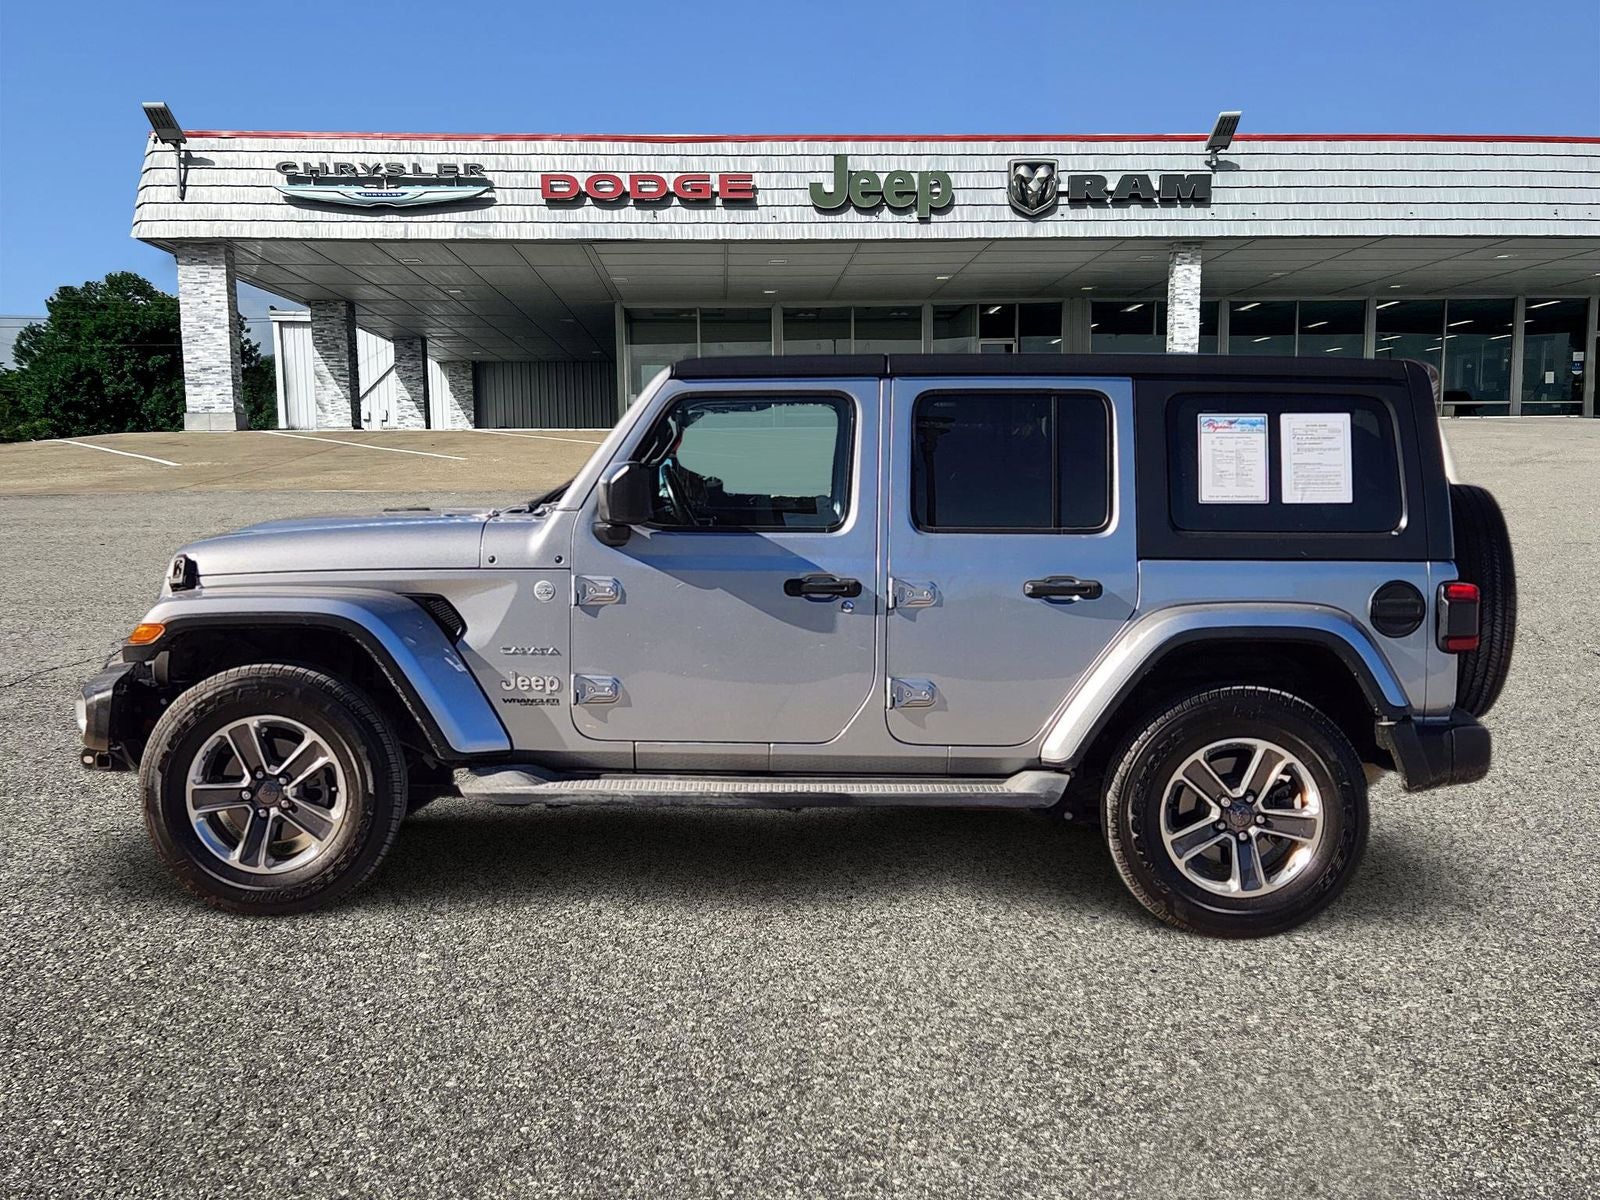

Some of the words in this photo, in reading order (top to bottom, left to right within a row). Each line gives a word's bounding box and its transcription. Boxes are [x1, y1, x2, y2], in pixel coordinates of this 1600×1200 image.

[275, 160, 487, 177] CHRYSLER
[540, 173, 757, 201] DODGE
[808, 154, 953, 219] Jeep
[1067, 173, 1212, 201] RAM
[501, 671, 561, 694] Jeep
